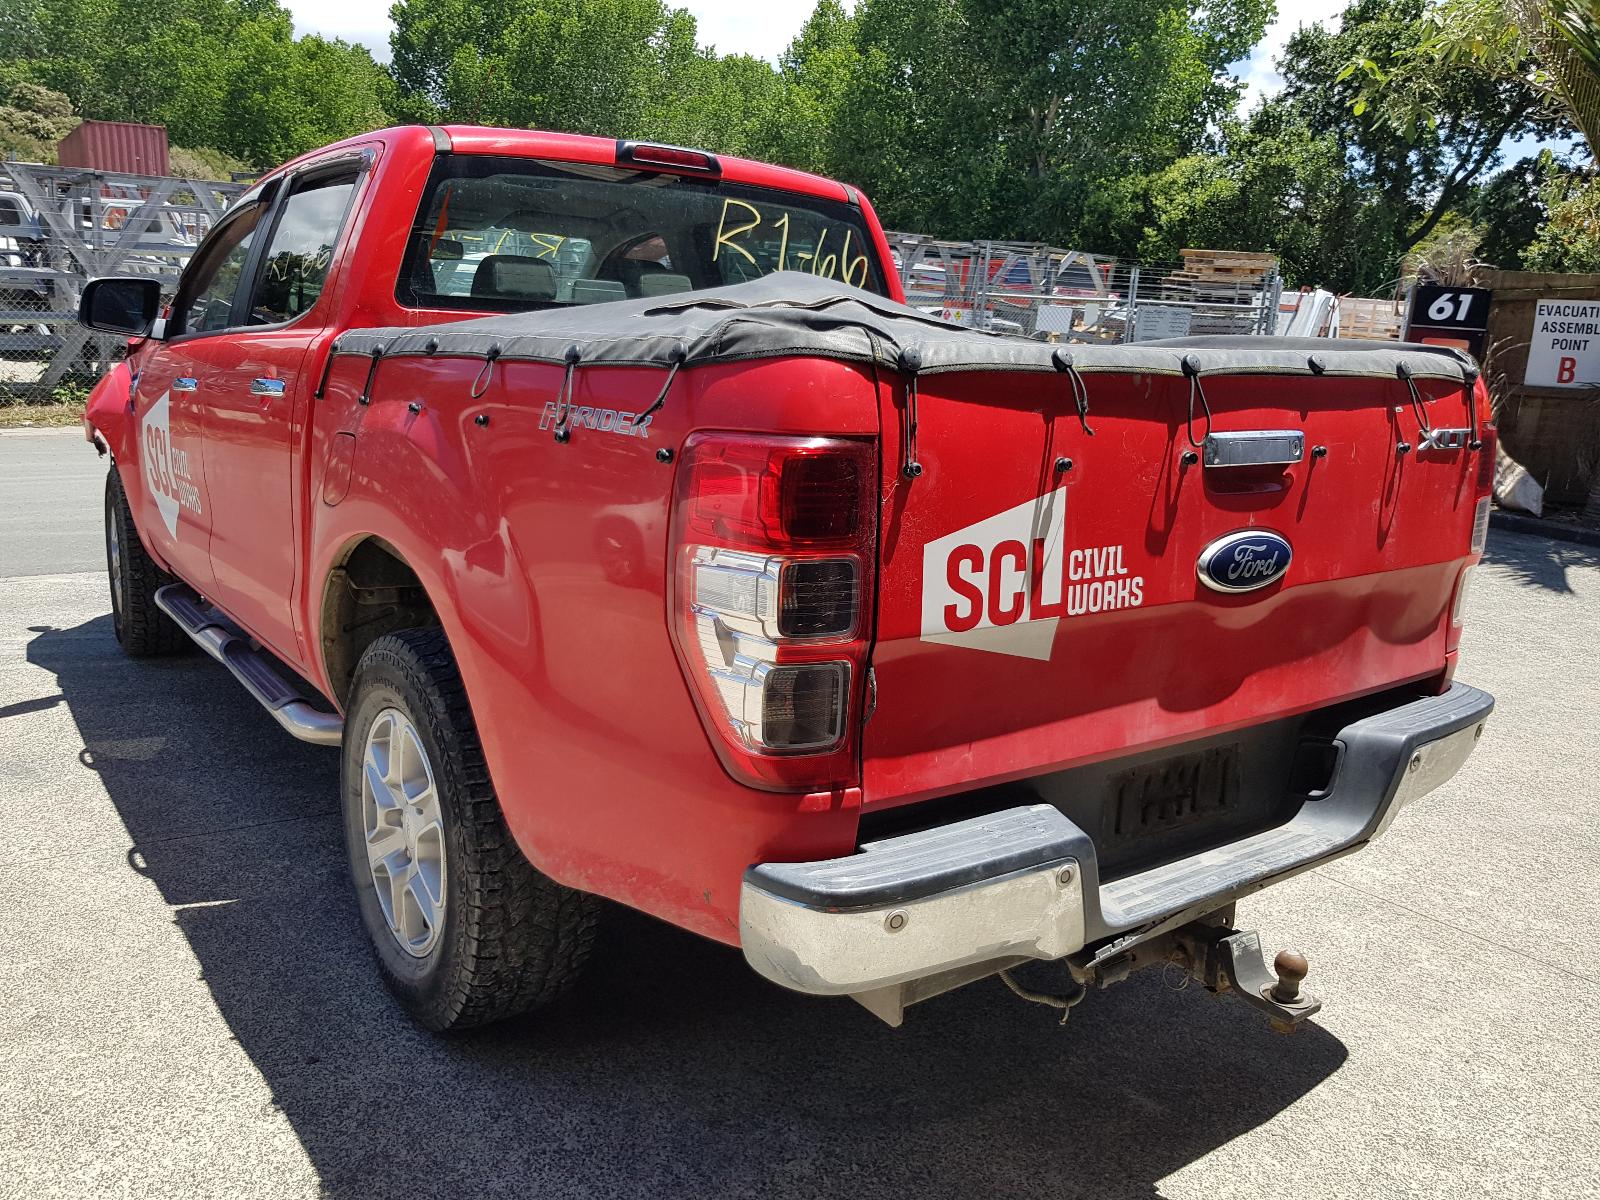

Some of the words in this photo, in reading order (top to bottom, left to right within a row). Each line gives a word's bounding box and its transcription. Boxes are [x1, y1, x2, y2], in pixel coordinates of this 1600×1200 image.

[1428, 293, 1473, 321] 61
[1551, 338, 1590, 351] POINT
[1557, 356, 1577, 384] B
[1417, 427, 1472, 450] XLT
[146, 423, 179, 502] SCL
[172, 447, 192, 480] CIVIL
[176, 478, 202, 515] WORKS
[1069, 545, 1128, 581] CIVIL
[1228, 544, 1279, 580] Ford
[944, 537, 1062, 632] SCL
[1066, 576, 1144, 616] WORKS
